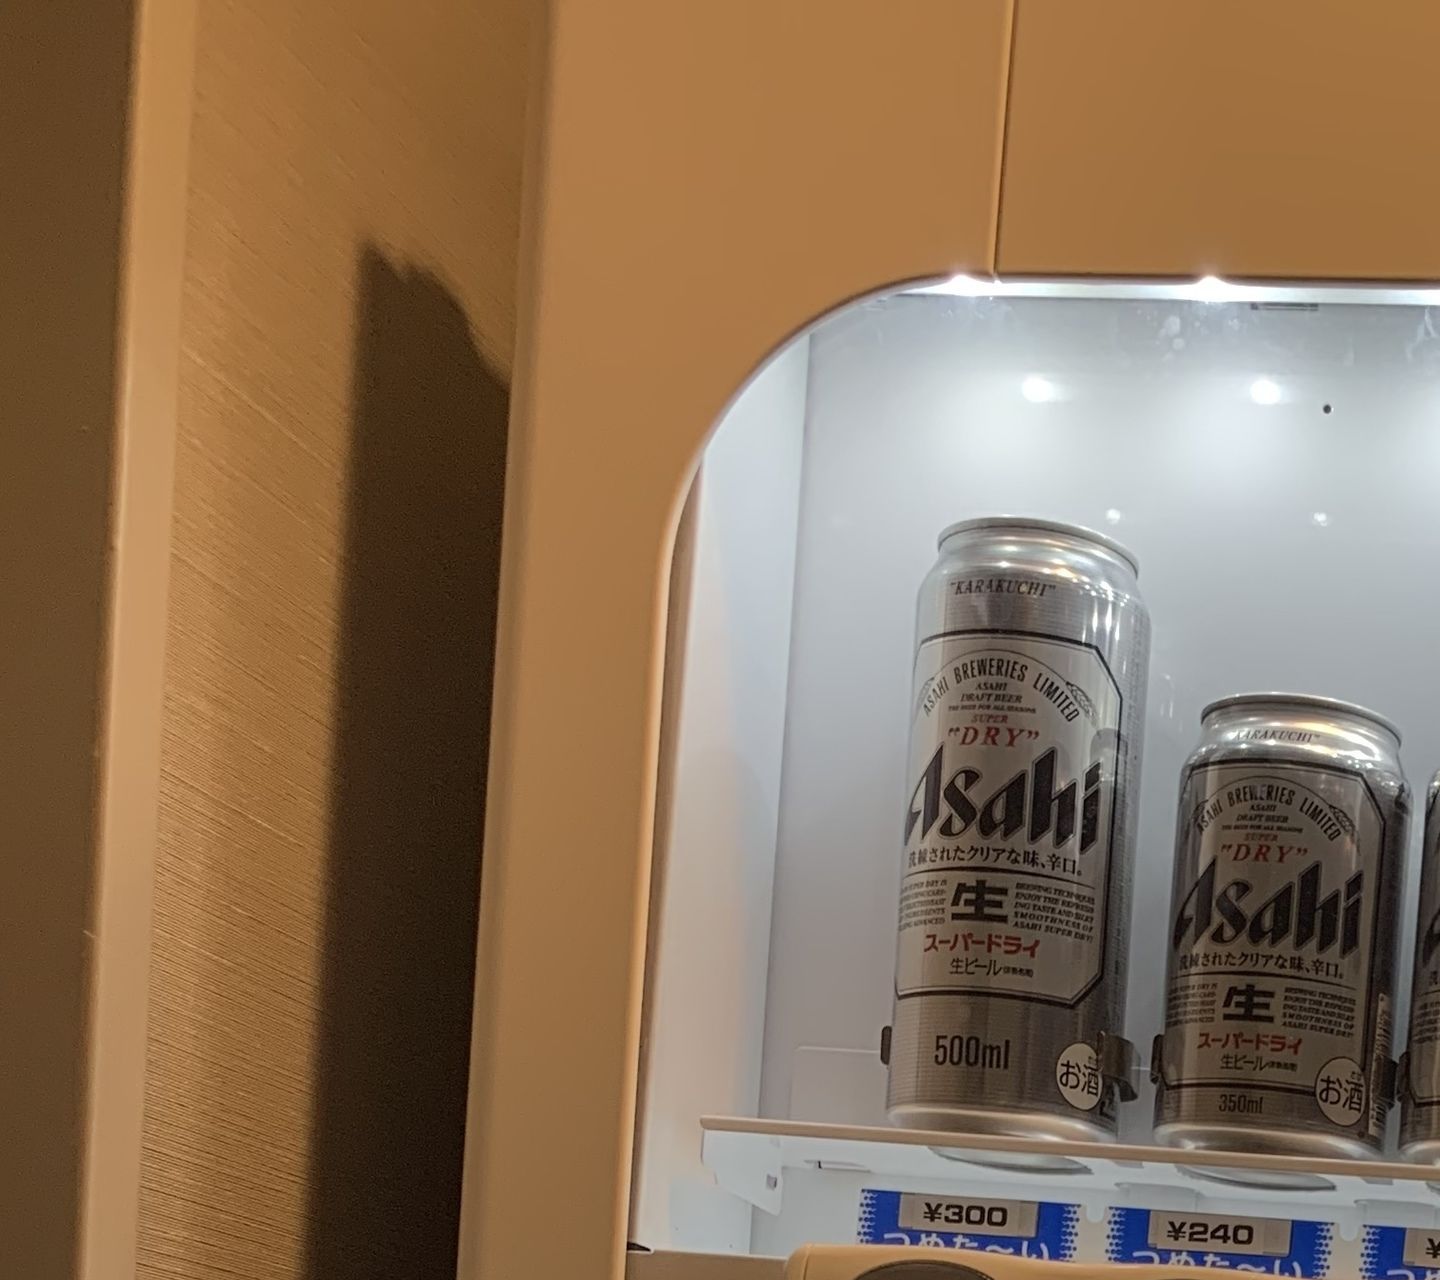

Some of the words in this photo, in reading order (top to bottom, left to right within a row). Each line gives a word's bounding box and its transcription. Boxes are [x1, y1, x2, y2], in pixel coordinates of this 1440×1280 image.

[922, 676, 950, 717] ASAHI
[954, 657, 1028, 684] BREWERIES
[1033, 676, 1080, 722] LIMITED
[904, 741, 1104, 852] Asahi
[1227, 783, 1297, 808] BREWERIES
[1299, 797, 1343, 842] LIMITED
[951, 879, 1009, 925] 生
[1173, 855, 1365, 961] Asahi
[924, 932, 1041, 959] スーパードライ
[1222, 984, 1276, 1024] 生
[934, 1034, 1010, 1071] 500ml
[1197, 1032, 1303, 1056] スーパードライ
[1058, 1055, 1103, 1098] お酒
[1318, 1074, 1364, 1114] お酒
[1218, 1094, 1264, 1115] 350ml
[922, 1201, 1009, 1228] ¥300
[1167, 1221, 1255, 1247] ¥240
